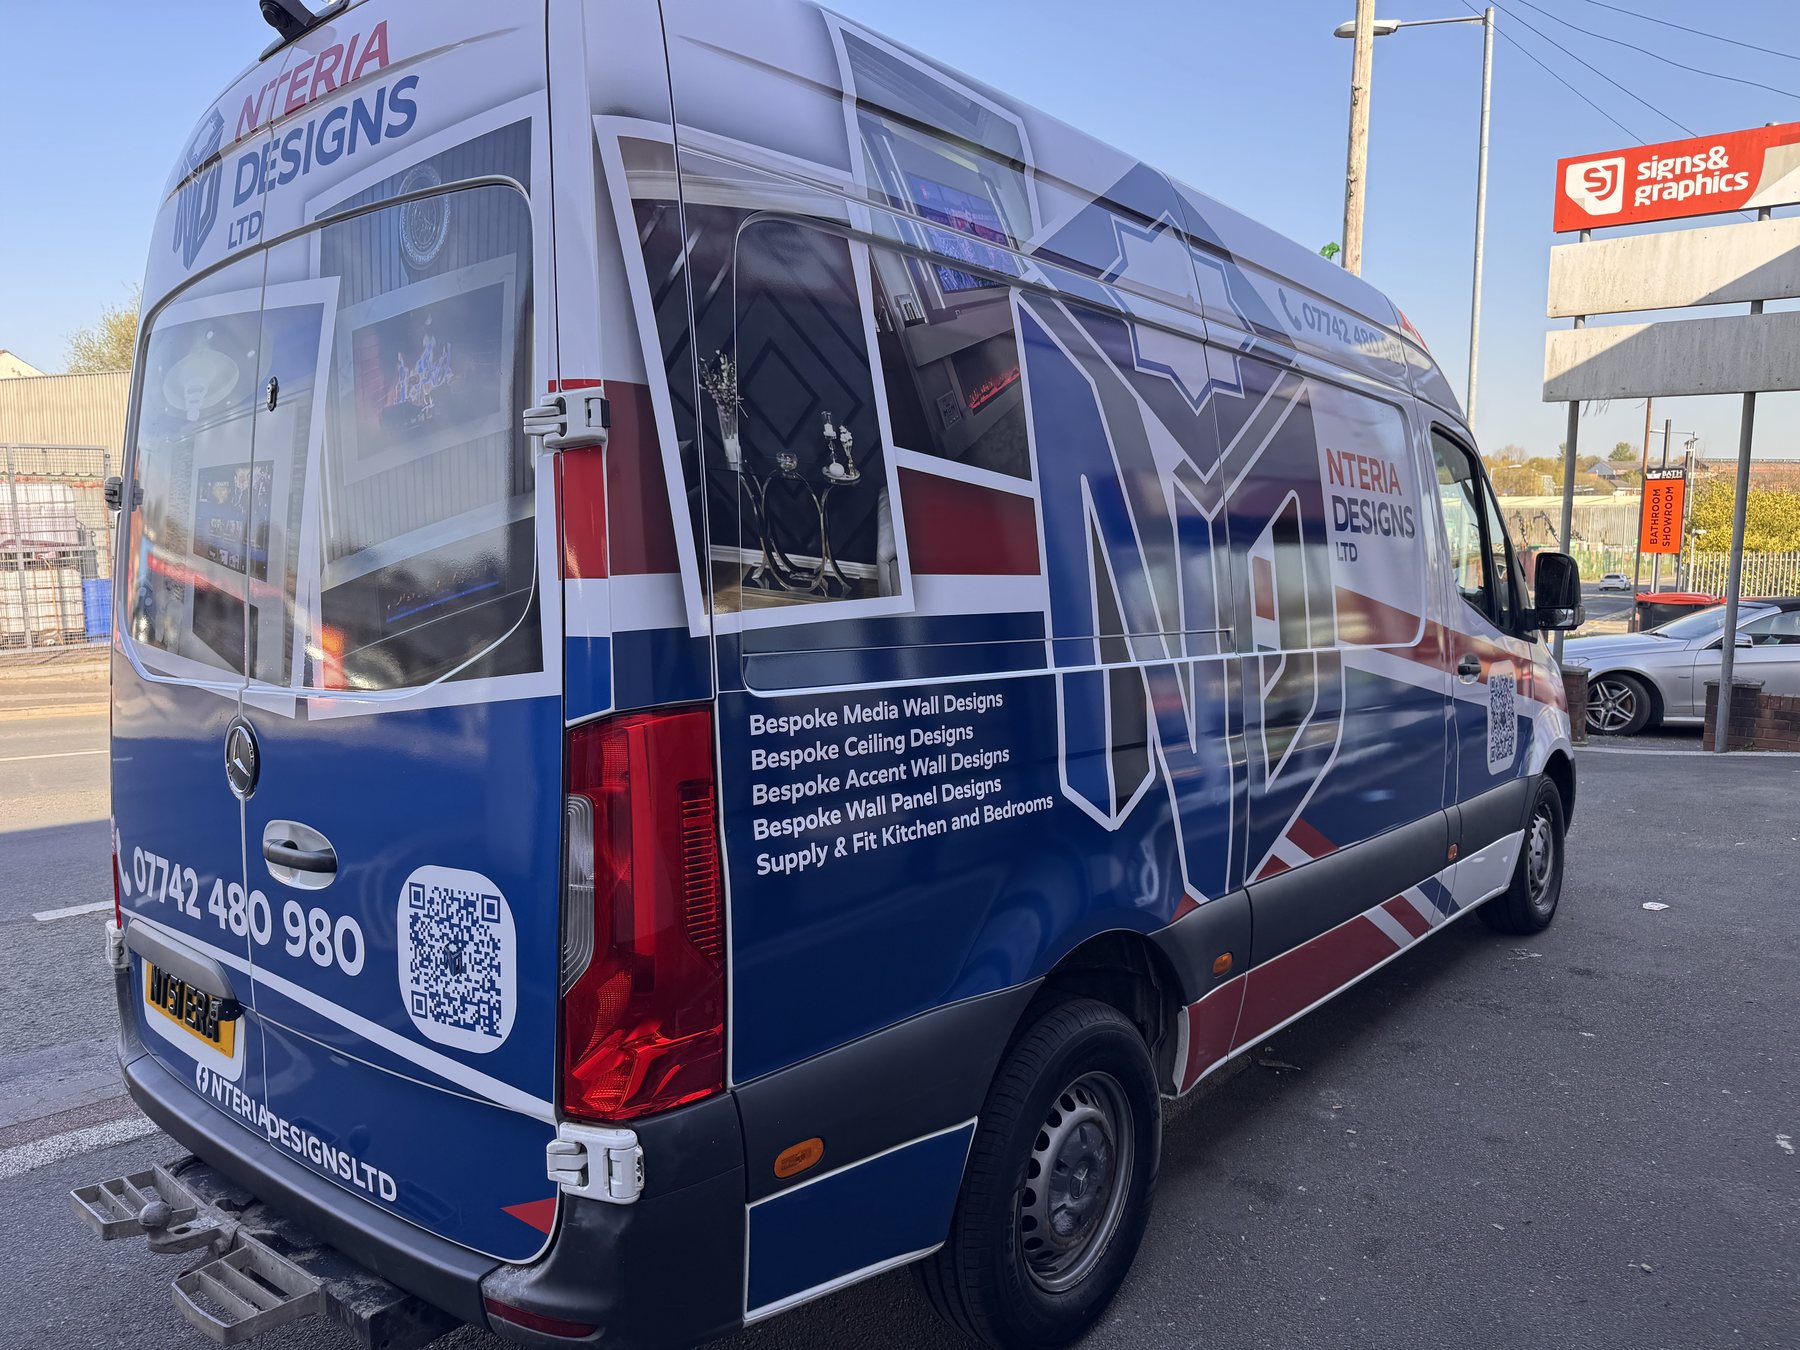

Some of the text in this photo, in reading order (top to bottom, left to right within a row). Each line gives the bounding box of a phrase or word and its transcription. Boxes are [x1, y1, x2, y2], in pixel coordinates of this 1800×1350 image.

[234, 20, 391, 143] NTERIA
[232, 75, 420, 207] DESIGNS
[1633, 171, 1749, 207] graphics
[227, 211, 262, 250] LTD
[1302, 302, 1351, 345] 07742
[1325, 448, 1402, 496] NTERIA
[1661, 469, 1682, 477] BATH
[1331, 495, 1415, 539] DESIGNS
[1649, 489, 1661, 545] BATHROOM
[1662, 486, 1674, 547] SHOWROOM
[1335, 542, 1358, 562] LTD
[750, 691, 1003, 736] Bespoke Media Wall Designs
[751, 724, 974, 771] Bespoke Ceiling Designs
[752, 747, 1010, 806] Bespoke Accent Wall Designs
[753, 777, 1002, 841] Bespoke Wall Panel Designs
[756, 795, 1054, 876] Supply & Fit Kitchen and Bedrooms
[133, 846, 365, 977] 07742 480 980
